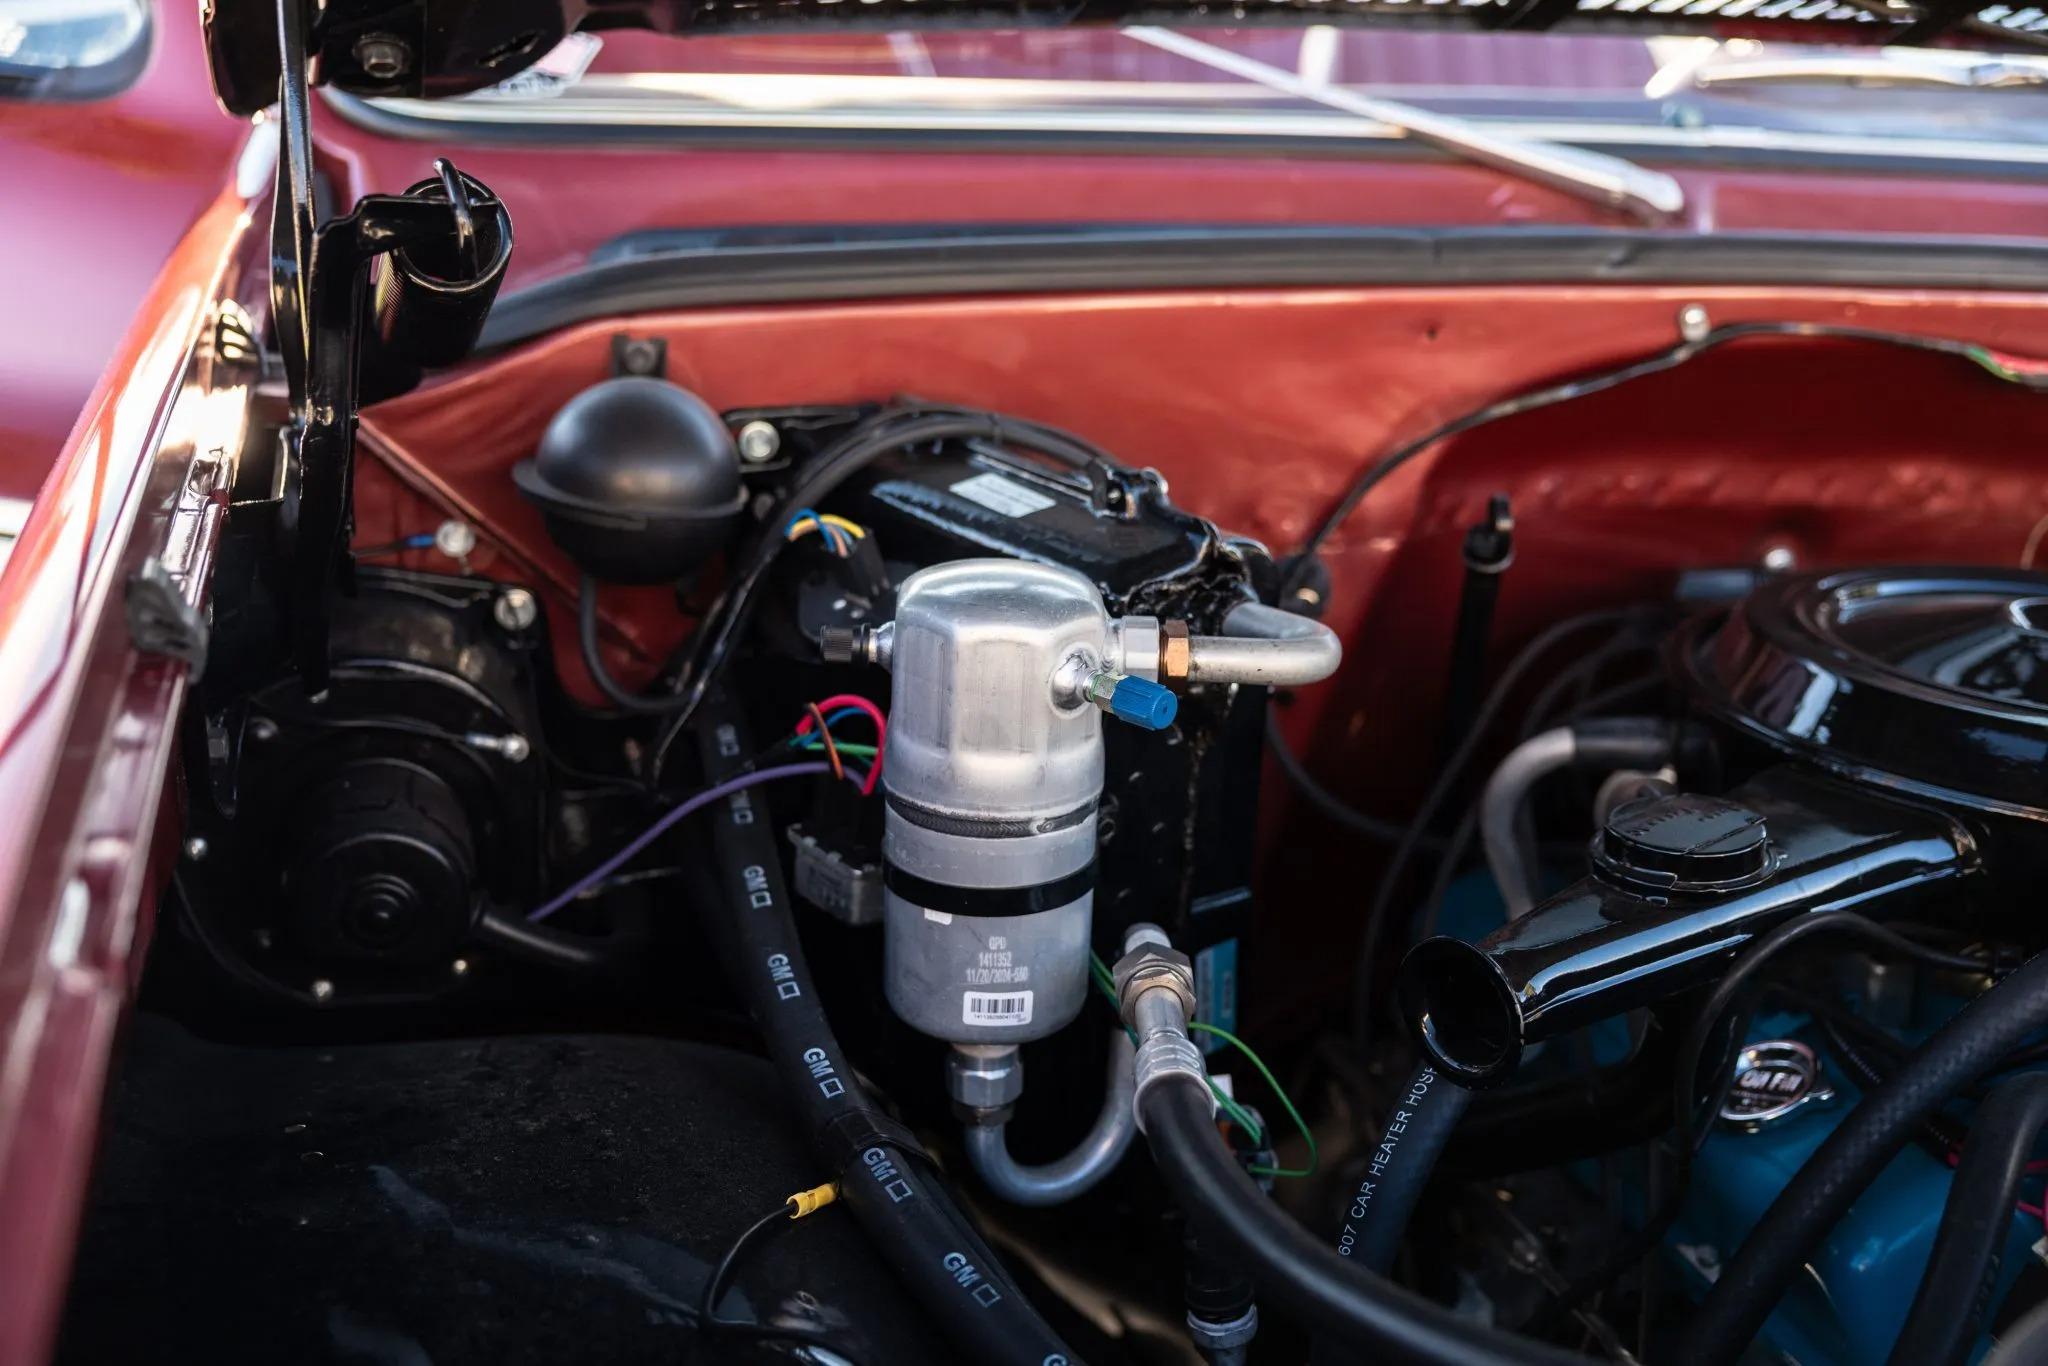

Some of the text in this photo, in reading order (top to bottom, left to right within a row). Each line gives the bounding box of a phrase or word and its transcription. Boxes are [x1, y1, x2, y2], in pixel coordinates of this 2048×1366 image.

[743, 865, 768, 894] GM
[767, 953, 794, 981] GM
[803, 1047, 835, 1078] GM
[863, 1147, 896, 1182] GM
[1338, 1224, 1357, 1256] 607
[1351, 1182, 1376, 1218] CAR
[1369, 1110, 1413, 1176] HEATER
[943, 1252, 981, 1288] GM
